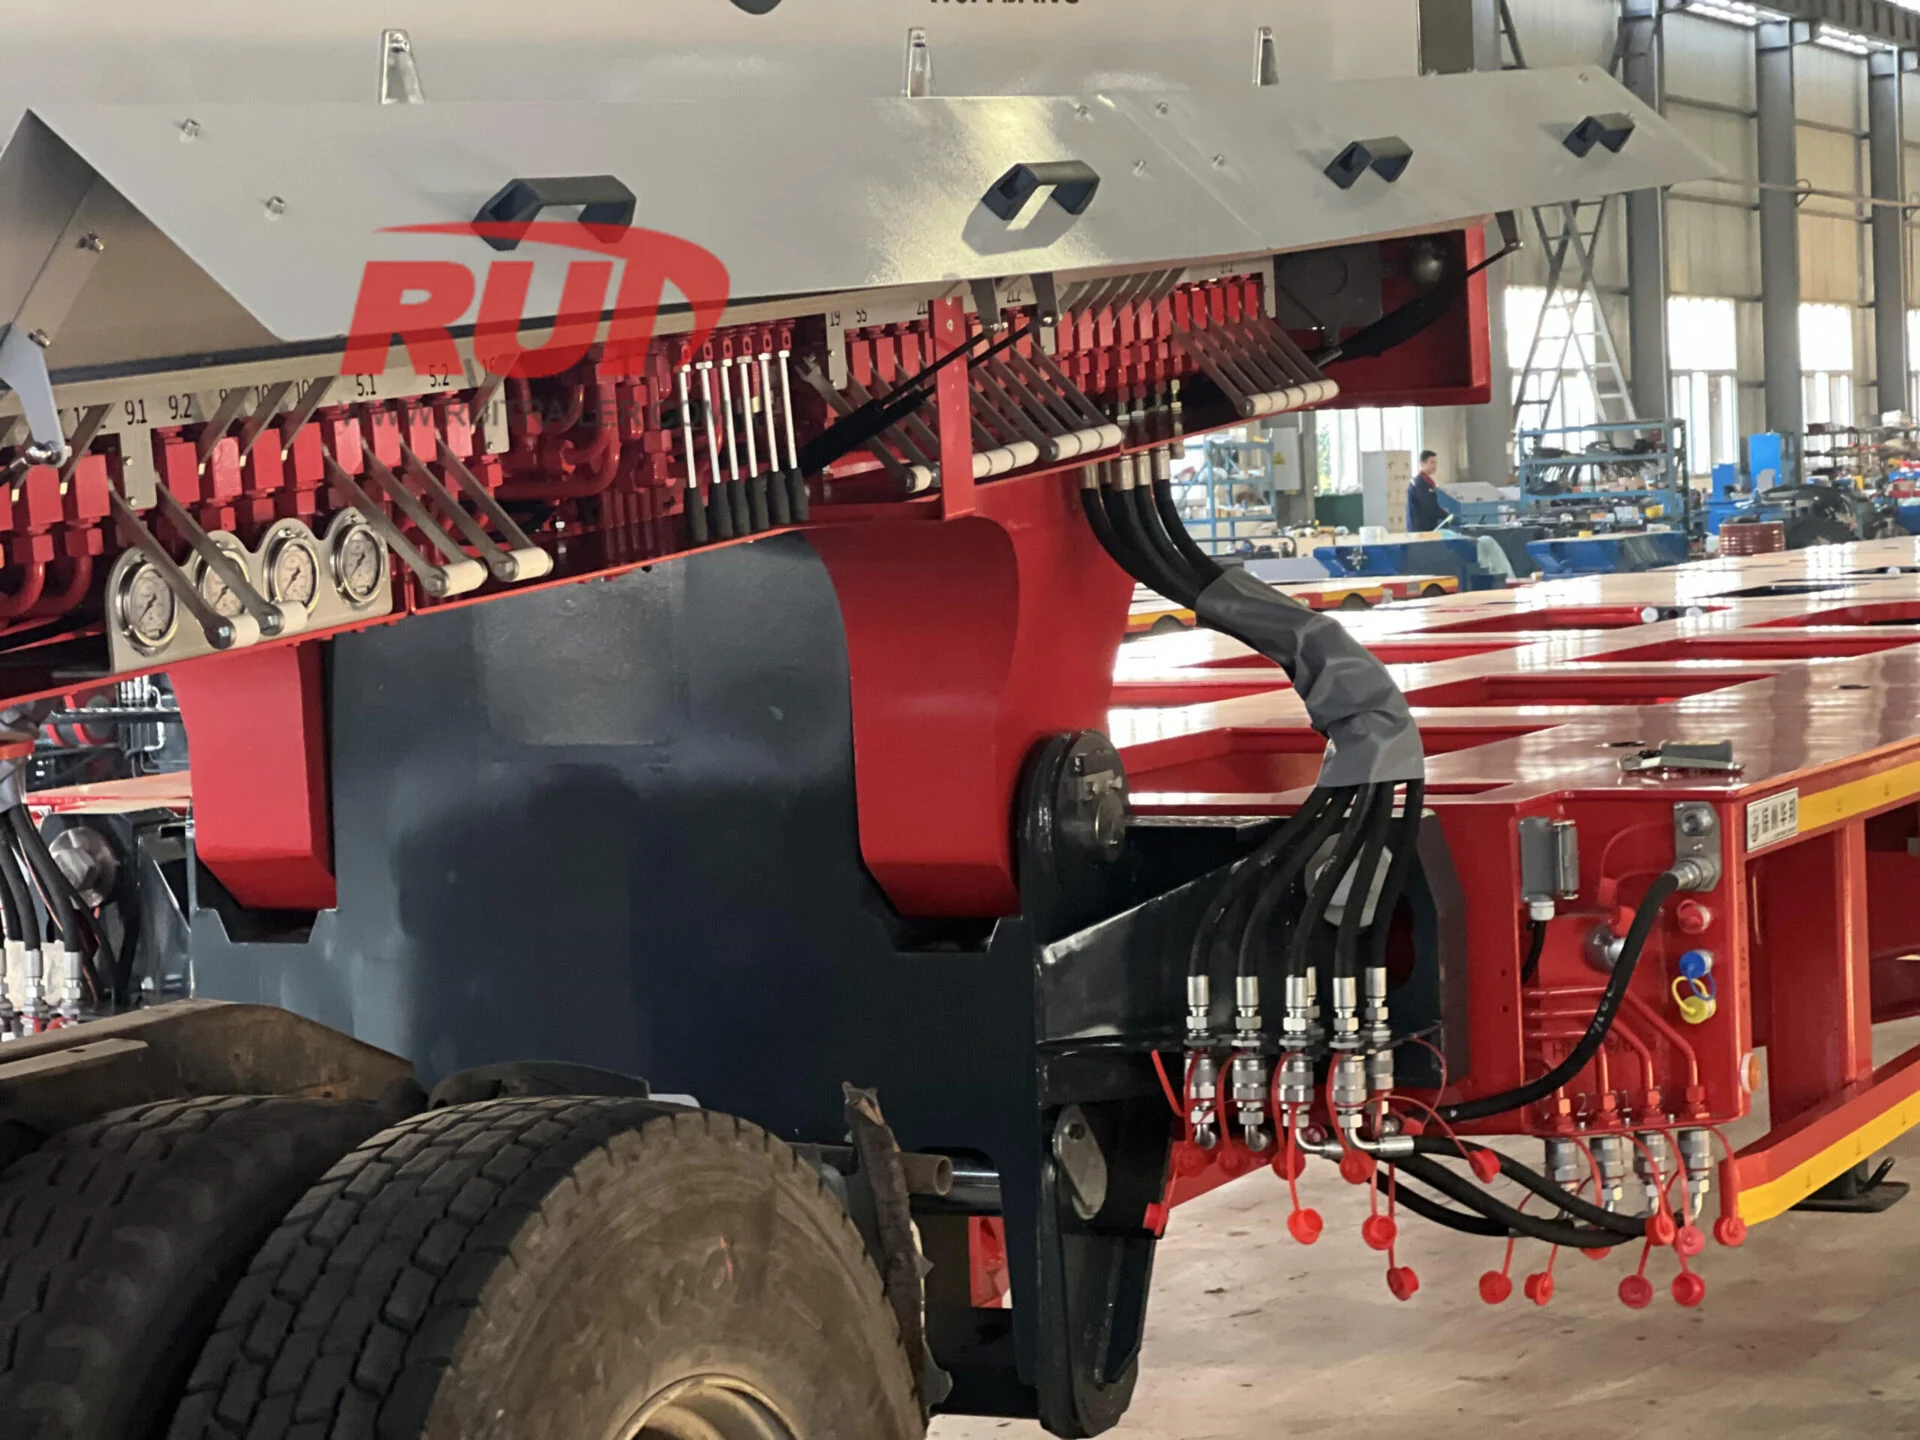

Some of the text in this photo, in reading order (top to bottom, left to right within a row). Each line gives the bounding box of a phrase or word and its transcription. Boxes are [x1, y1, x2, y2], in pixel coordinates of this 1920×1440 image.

[355, 373, 377, 396] 5.1
[428, 363, 450, 387] 5.2
[124, 399, 148, 425] 9.1
[168, 393, 193, 419] 9.2
